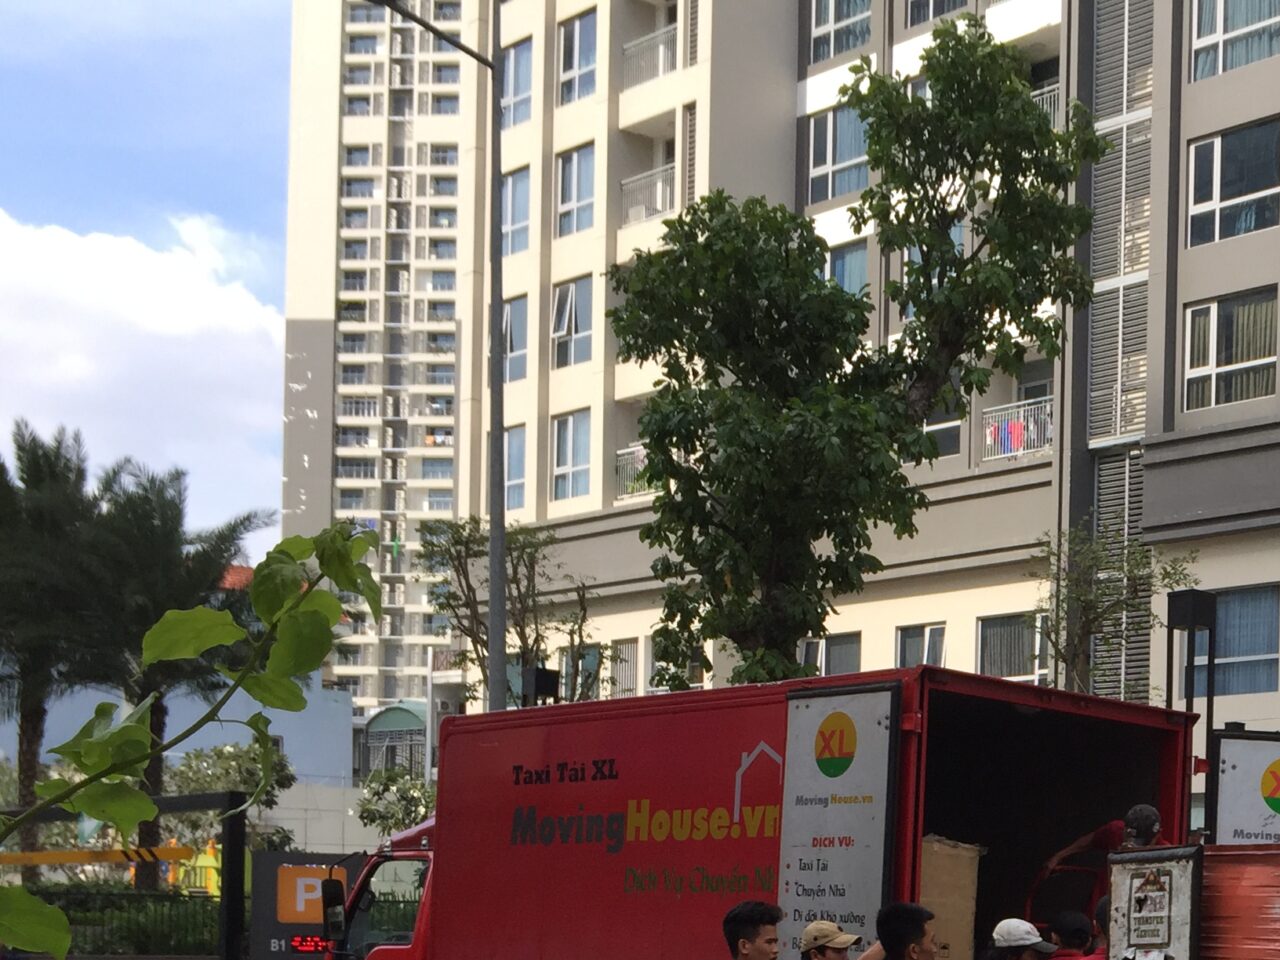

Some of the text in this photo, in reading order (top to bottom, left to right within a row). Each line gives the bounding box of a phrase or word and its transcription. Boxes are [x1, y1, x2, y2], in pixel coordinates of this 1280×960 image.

[818, 728, 855, 759] XL
[512, 764, 551, 786] Taxi
[590, 758, 619, 781] XL
[798, 858, 814, 872] Taxi
[296, 877, 322, 913] P
[270, 939, 286, 951] B1
